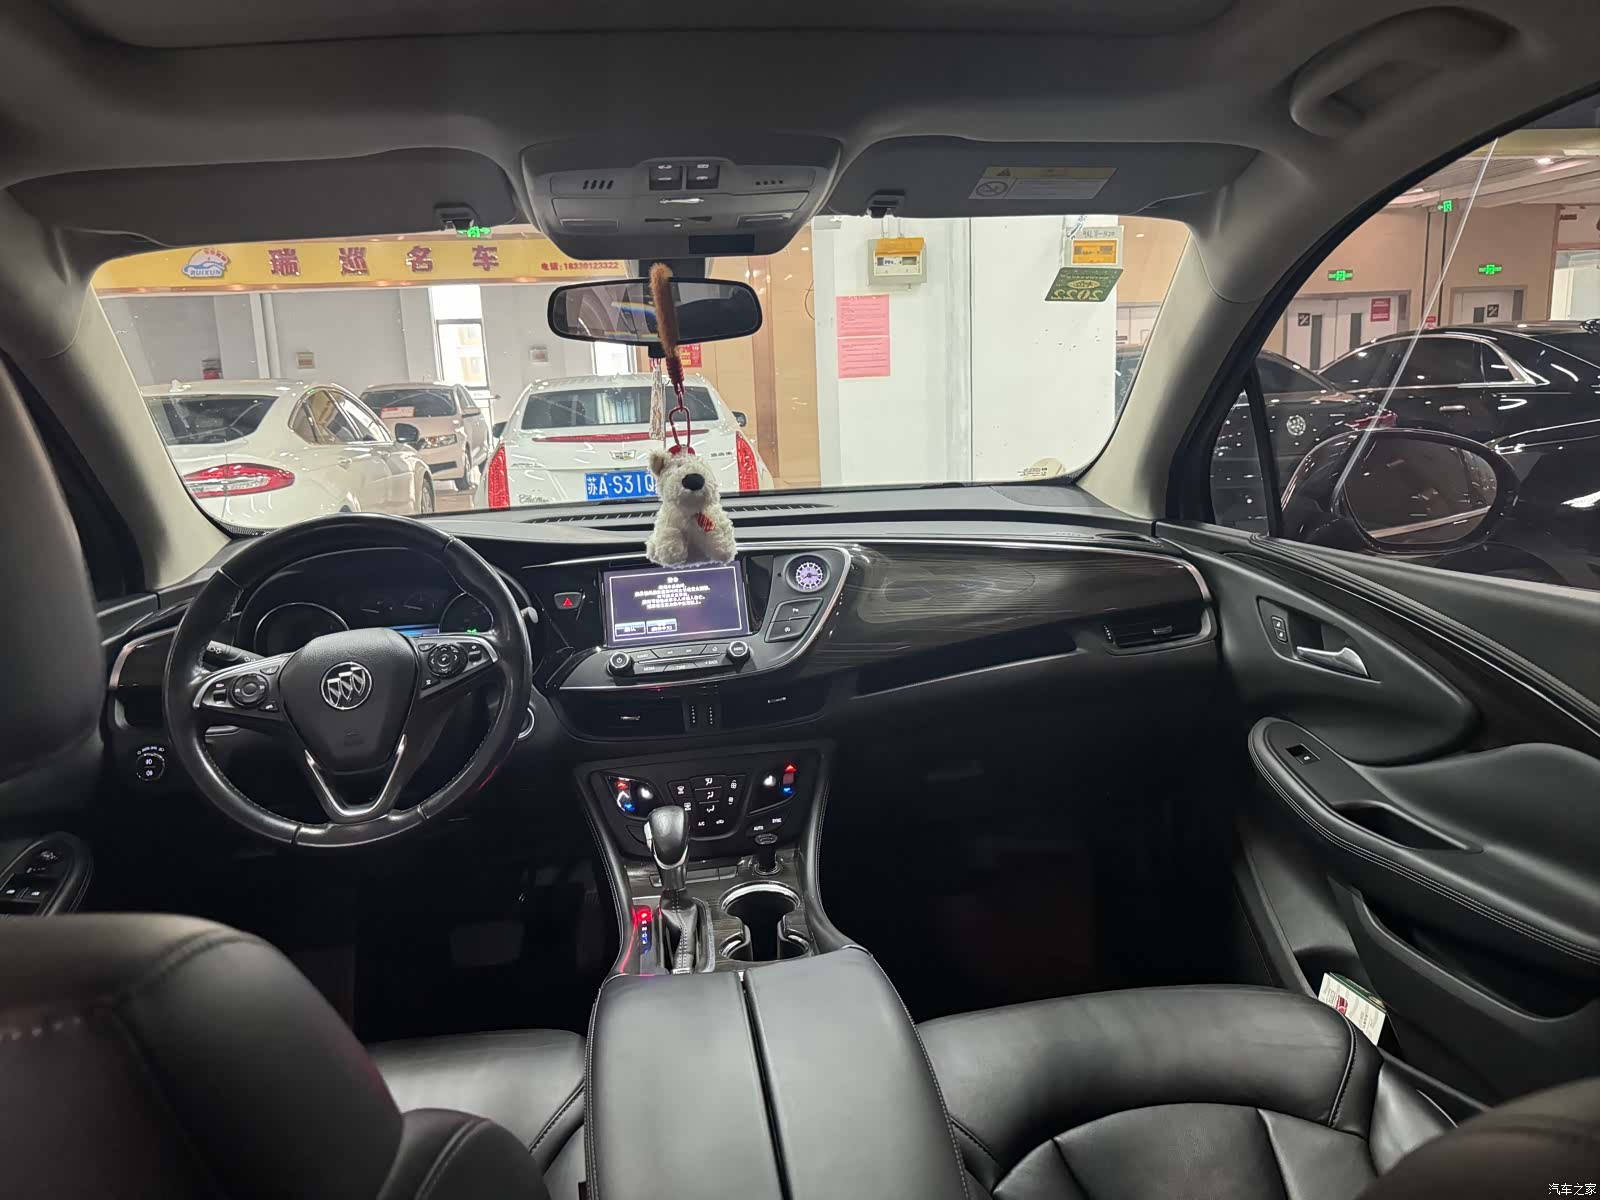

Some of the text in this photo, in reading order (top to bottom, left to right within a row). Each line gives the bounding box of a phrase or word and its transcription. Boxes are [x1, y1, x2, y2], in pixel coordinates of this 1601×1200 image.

[268, 245, 499, 276] 瑞巡名车
[587, 474, 657, 496] 苏A·S31Q
